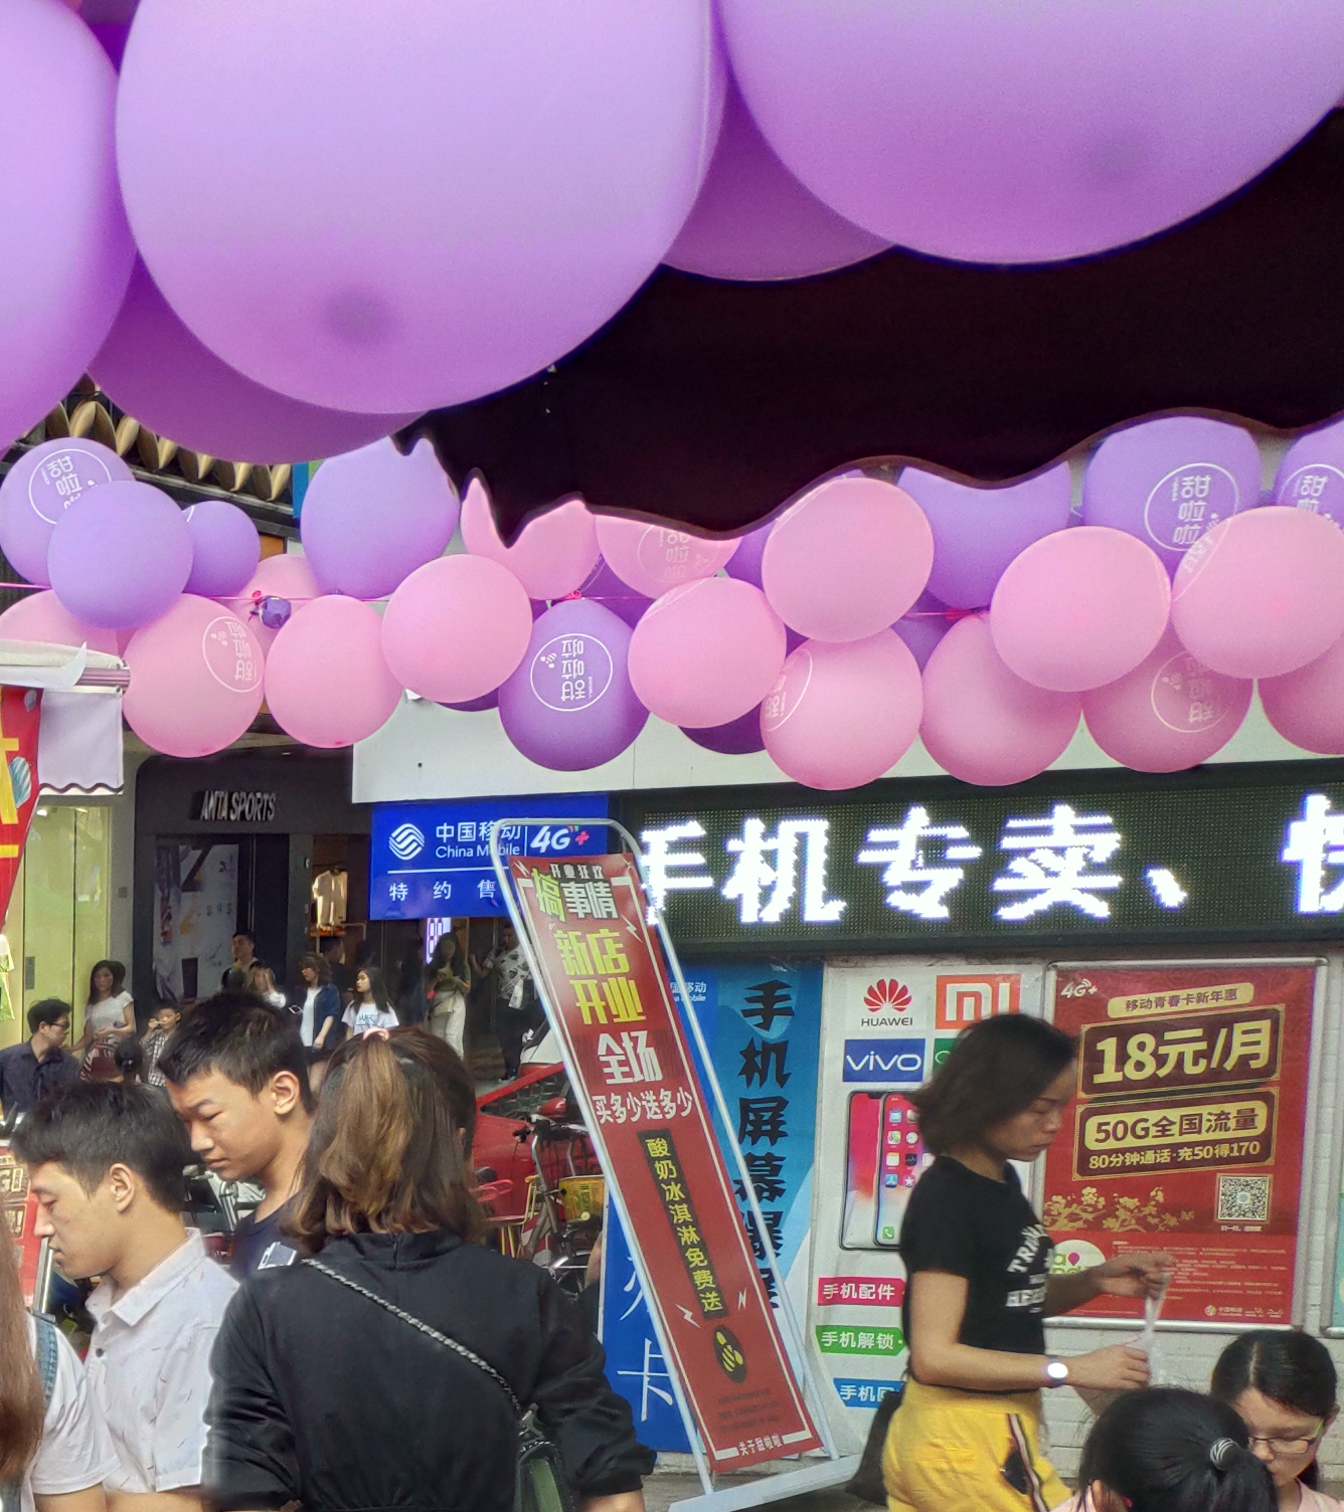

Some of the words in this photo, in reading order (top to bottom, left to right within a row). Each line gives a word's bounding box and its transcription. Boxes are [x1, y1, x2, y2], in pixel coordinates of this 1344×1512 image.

[230, 790, 276, 821] SPORTS
[435, 845, 474, 858] China
[476, 843, 521, 858] Mbile
[532, 867, 619, 923] 搞事情
[554, 928, 630, 976] 新店
[569, 977, 647, 1025] 开业
[1125, 987, 1238, 1012] 移动青春卡新年惠
[861, 1017, 913, 1027] HUAWEI
[597, 1030, 663, 1085] 全场
[1092, 1018, 1272, 1085] 18元/月
[592, 1086, 694, 1125] 买多少送多少
[1094, 1107, 1259, 1144] 50G全国流量
[645, 1137, 724, 1313] 酸奶冰淇淋免费送
[822, 1283, 896, 1301] 手机配件
[821, 1331, 895, 1350] 手机解锁
[839, 1385, 899, 1402] 手机回
